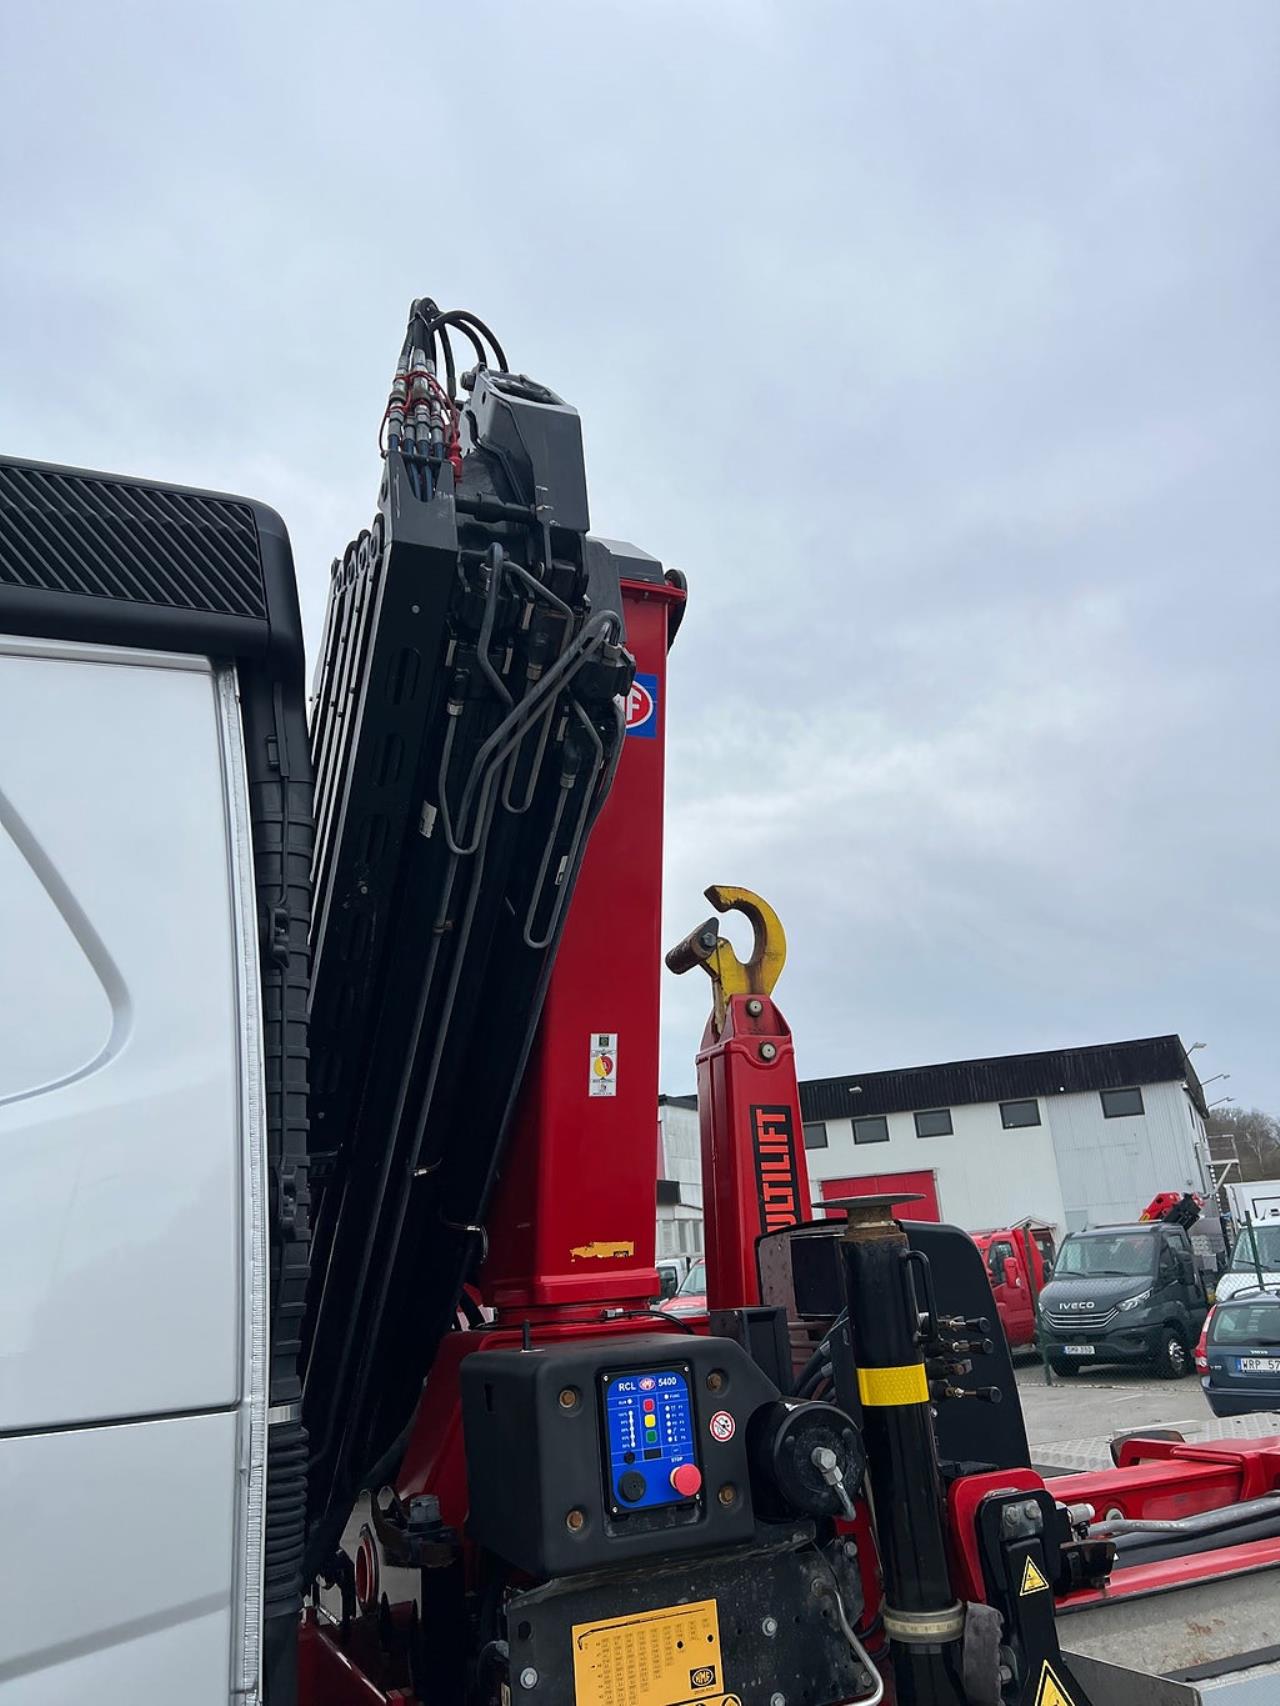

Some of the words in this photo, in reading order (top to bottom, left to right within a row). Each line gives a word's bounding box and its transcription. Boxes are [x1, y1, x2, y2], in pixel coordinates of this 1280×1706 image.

[1059, 1301, 1095, 1310] IVECO
[1242, 1360, 1261, 1369] WRP
[618, 1382, 636, 1391] RCL
[658, 1377, 677, 1387] 5400
